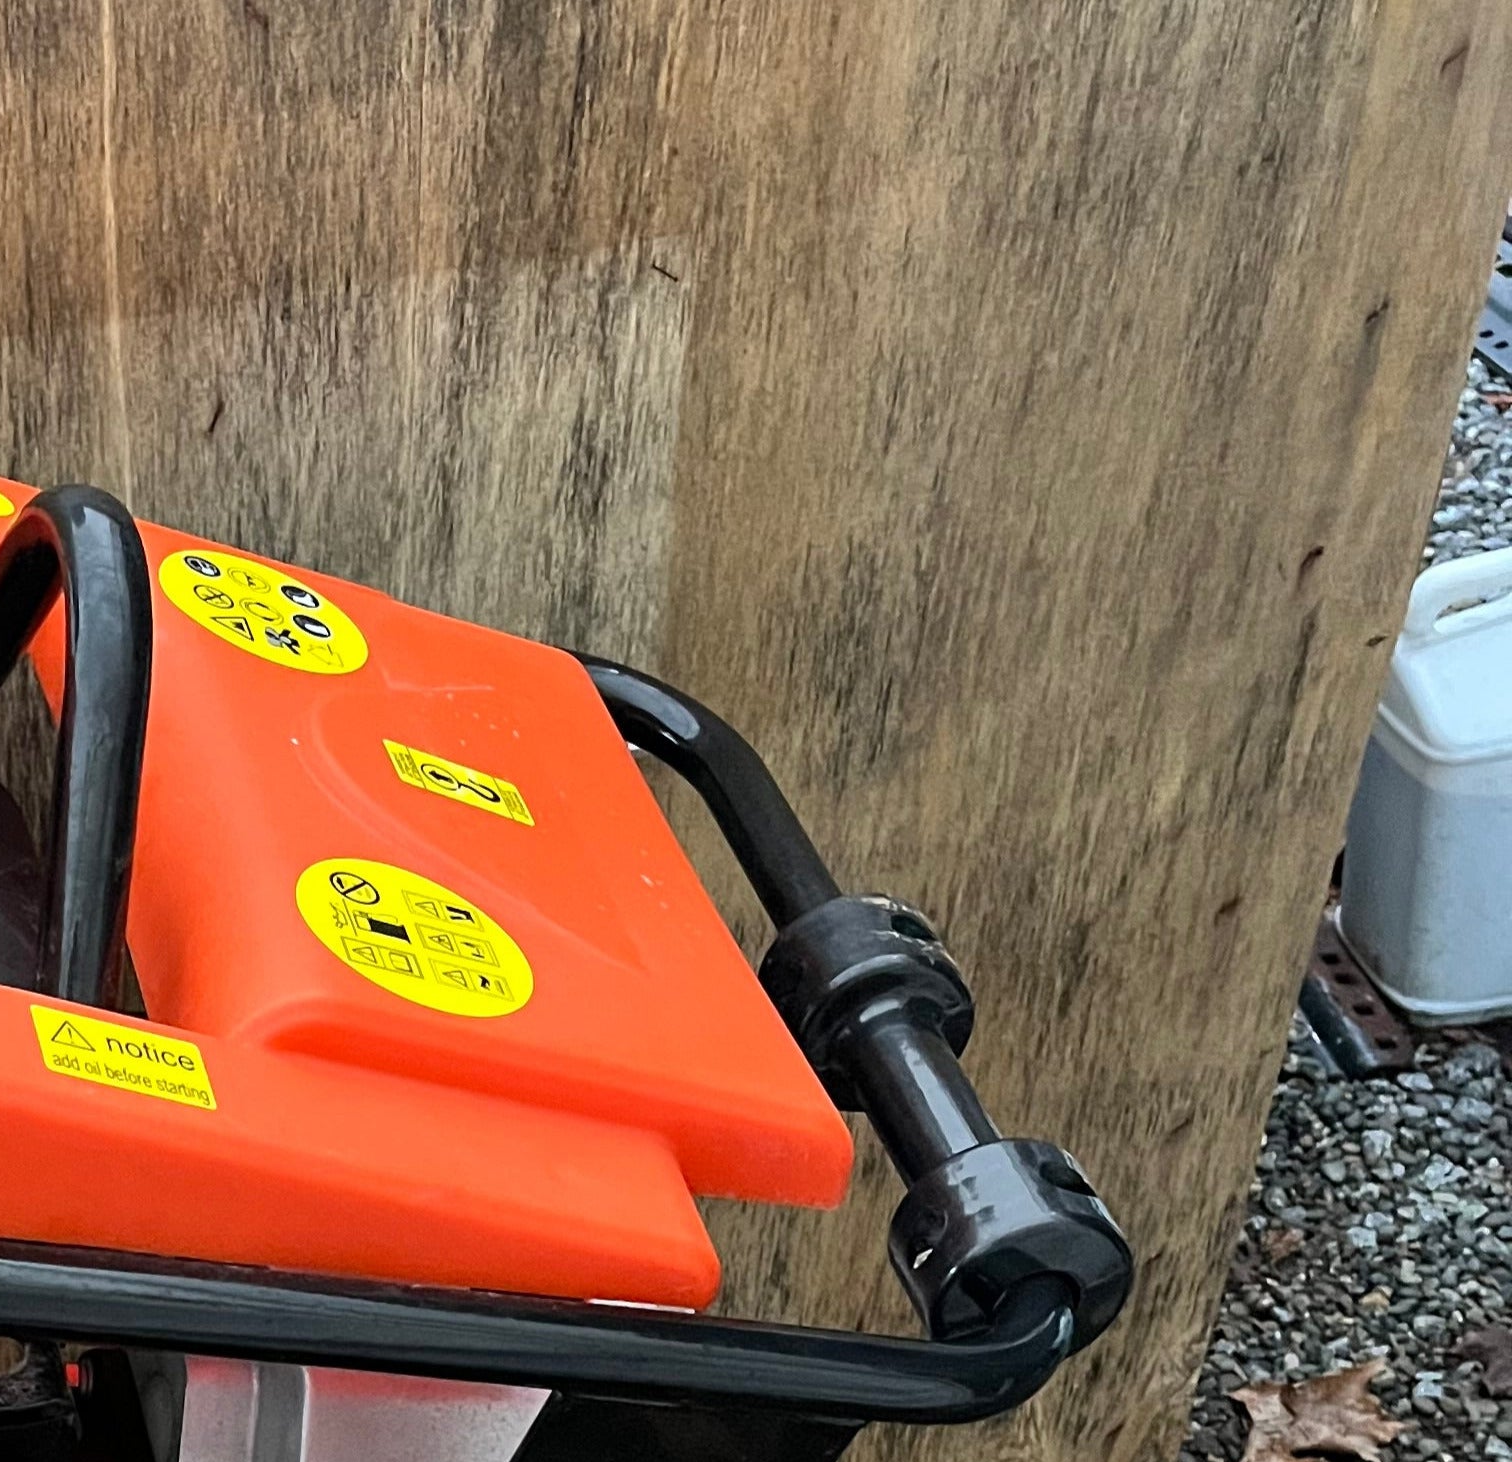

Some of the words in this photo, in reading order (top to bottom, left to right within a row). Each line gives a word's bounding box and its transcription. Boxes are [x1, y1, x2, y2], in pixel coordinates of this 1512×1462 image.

[106, 1036, 195, 1071] notice
[53, 1053, 80, 1071] add
[85, 1062, 101, 1076] oil
[105, 1064, 152, 1088] before
[156, 1078, 211, 1106] starting
